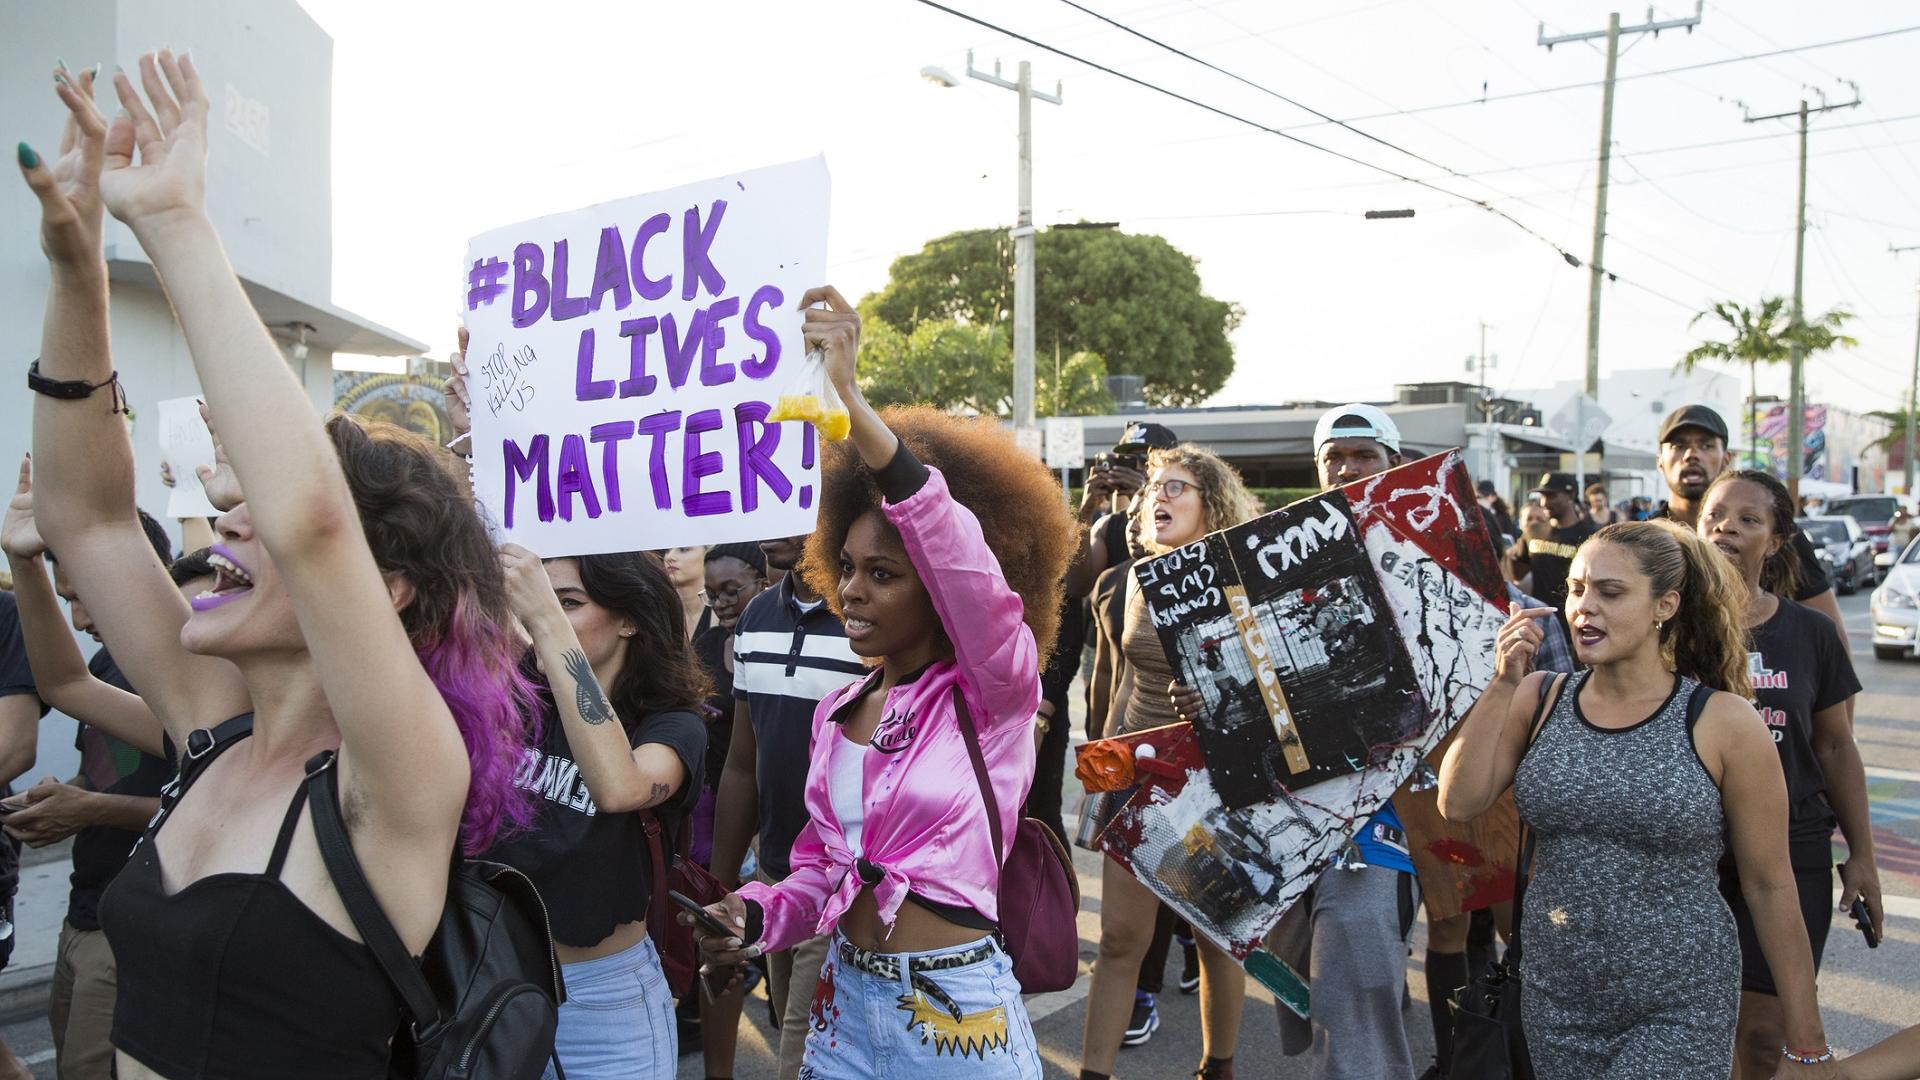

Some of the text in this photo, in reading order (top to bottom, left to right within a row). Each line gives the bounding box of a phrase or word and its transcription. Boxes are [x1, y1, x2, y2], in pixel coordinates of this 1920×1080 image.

[468, 200, 728, 328] #BLACK
[481, 342, 508, 389] STOP
[486, 344, 537, 419] KILLING
[576, 285, 784, 401] LIVES
[511, 380, 535, 412] US
[504, 401, 815, 529] MATTER!
[1246, 500, 1348, 579] FUCK!
